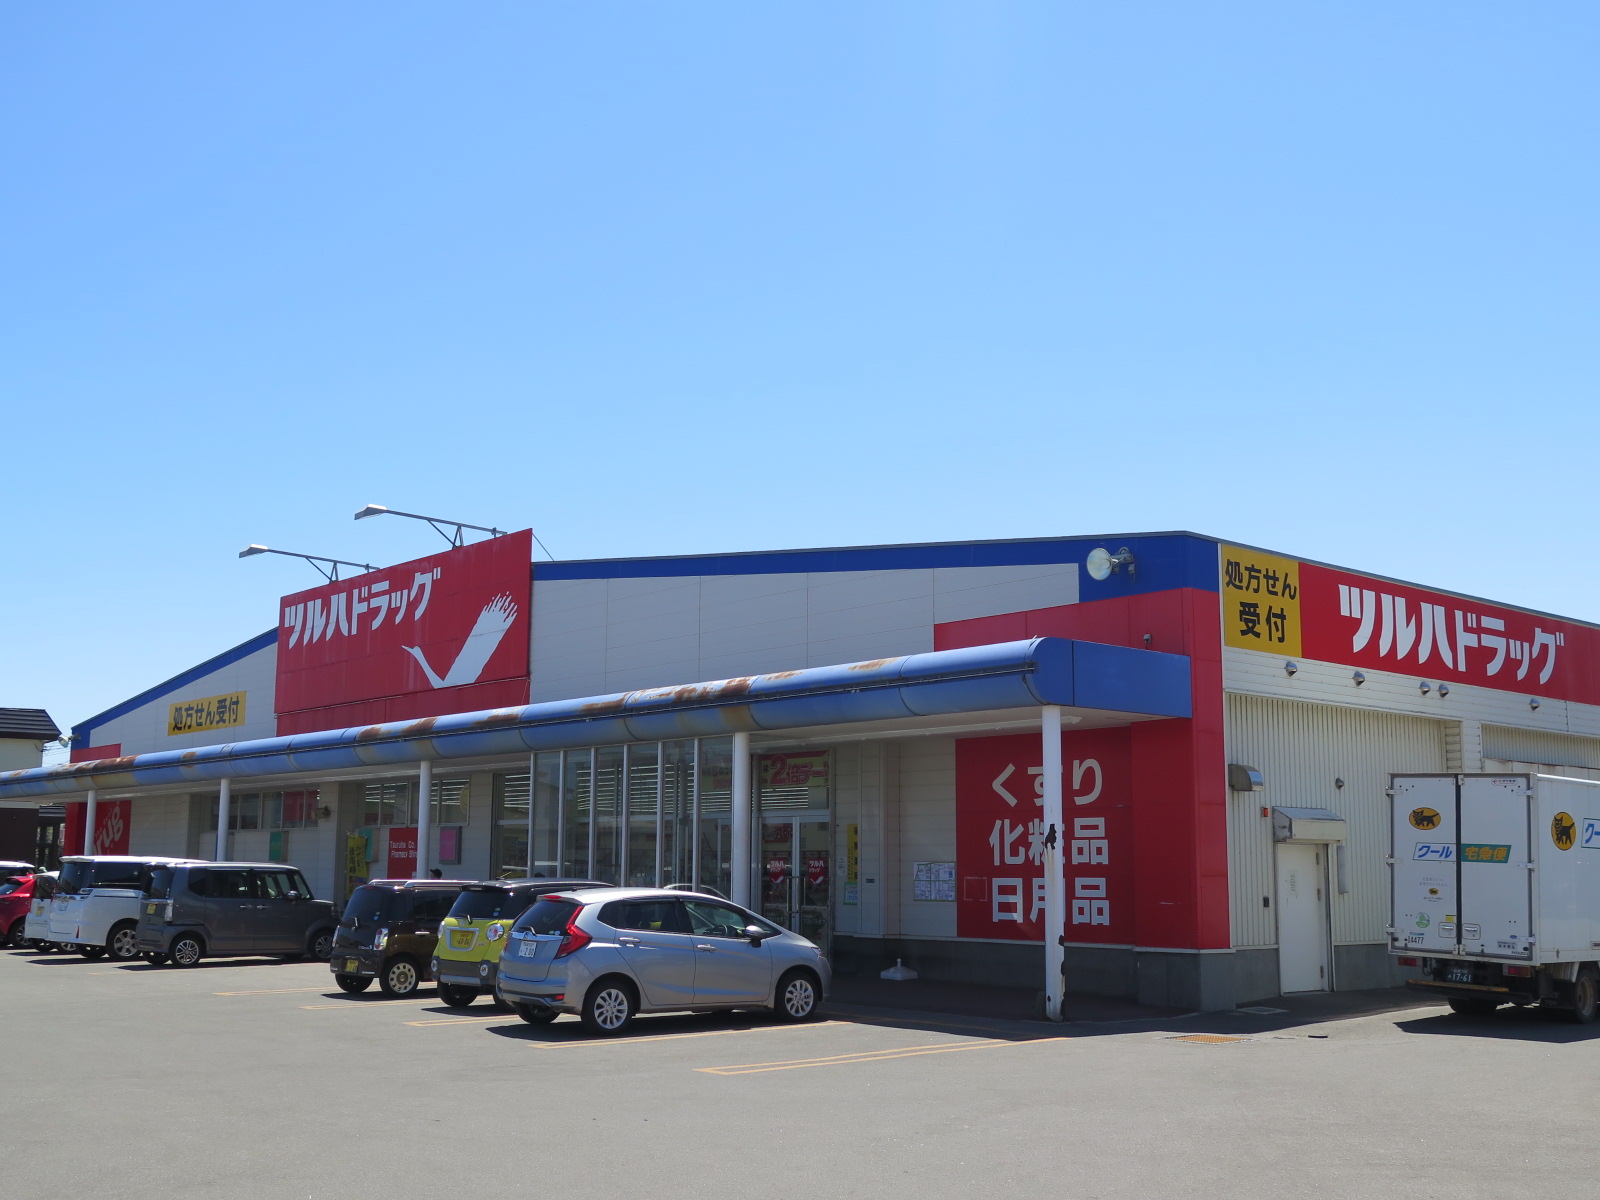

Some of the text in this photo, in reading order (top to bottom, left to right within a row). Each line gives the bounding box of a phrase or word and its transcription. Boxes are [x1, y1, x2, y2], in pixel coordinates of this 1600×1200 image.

[1225, 558, 1297, 600] 処方せん
[284, 566, 441, 650] ツルハドラッグ
[1238, 601, 1287, 643] 受付
[1338, 583, 1565, 685] ツルハドラッグ
[172, 695, 240, 732] 処方せん受付
[1417, 845, 1508, 861] クール 宅急便
